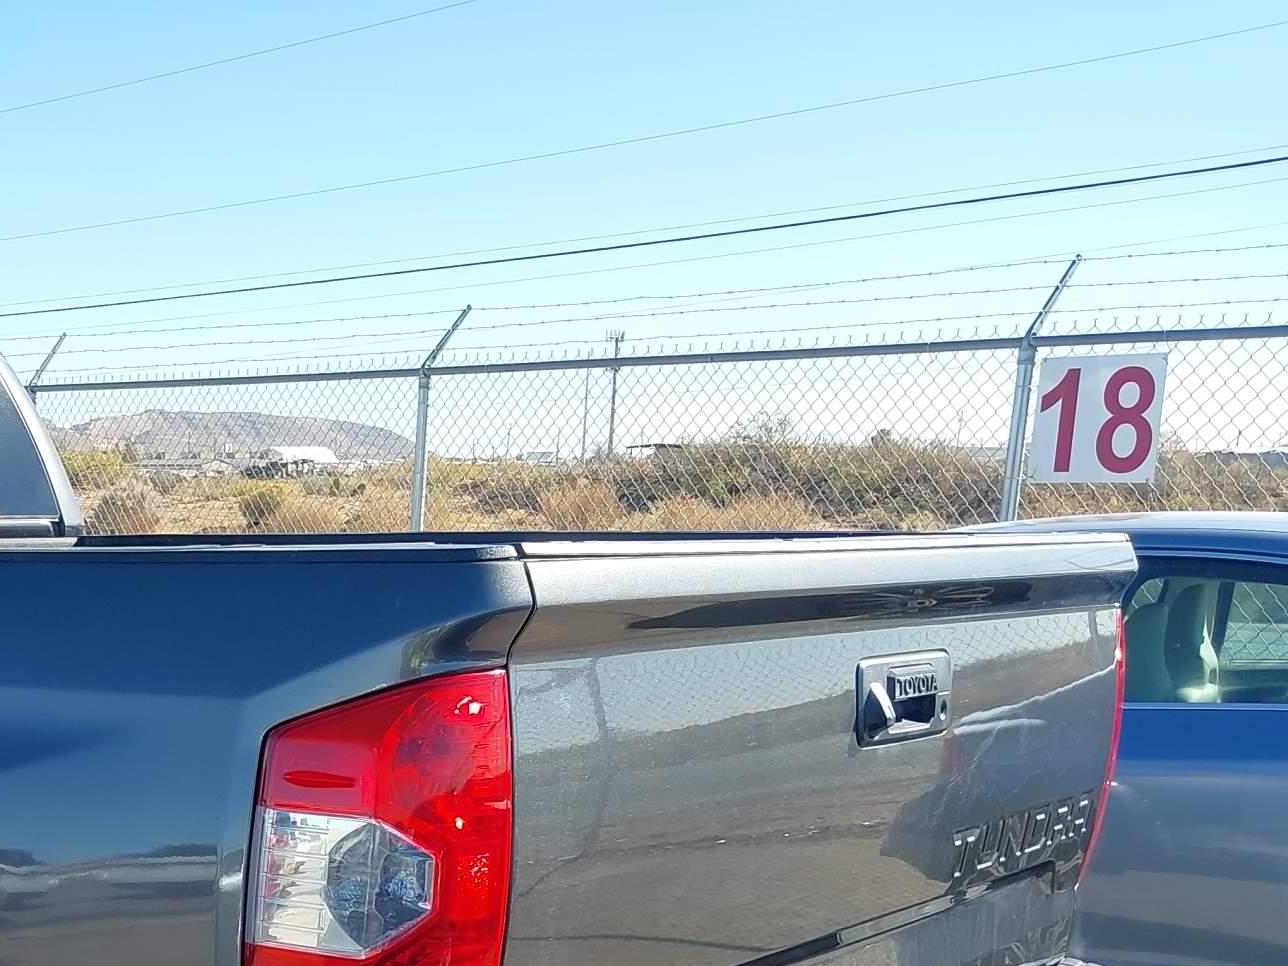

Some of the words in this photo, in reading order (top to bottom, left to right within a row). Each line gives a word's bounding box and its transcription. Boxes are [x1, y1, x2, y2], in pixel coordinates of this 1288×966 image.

[1040, 366, 1156, 474] 18
[896, 673, 938, 698] TOYOTA
[953, 789, 1094, 878] TUNDRA
